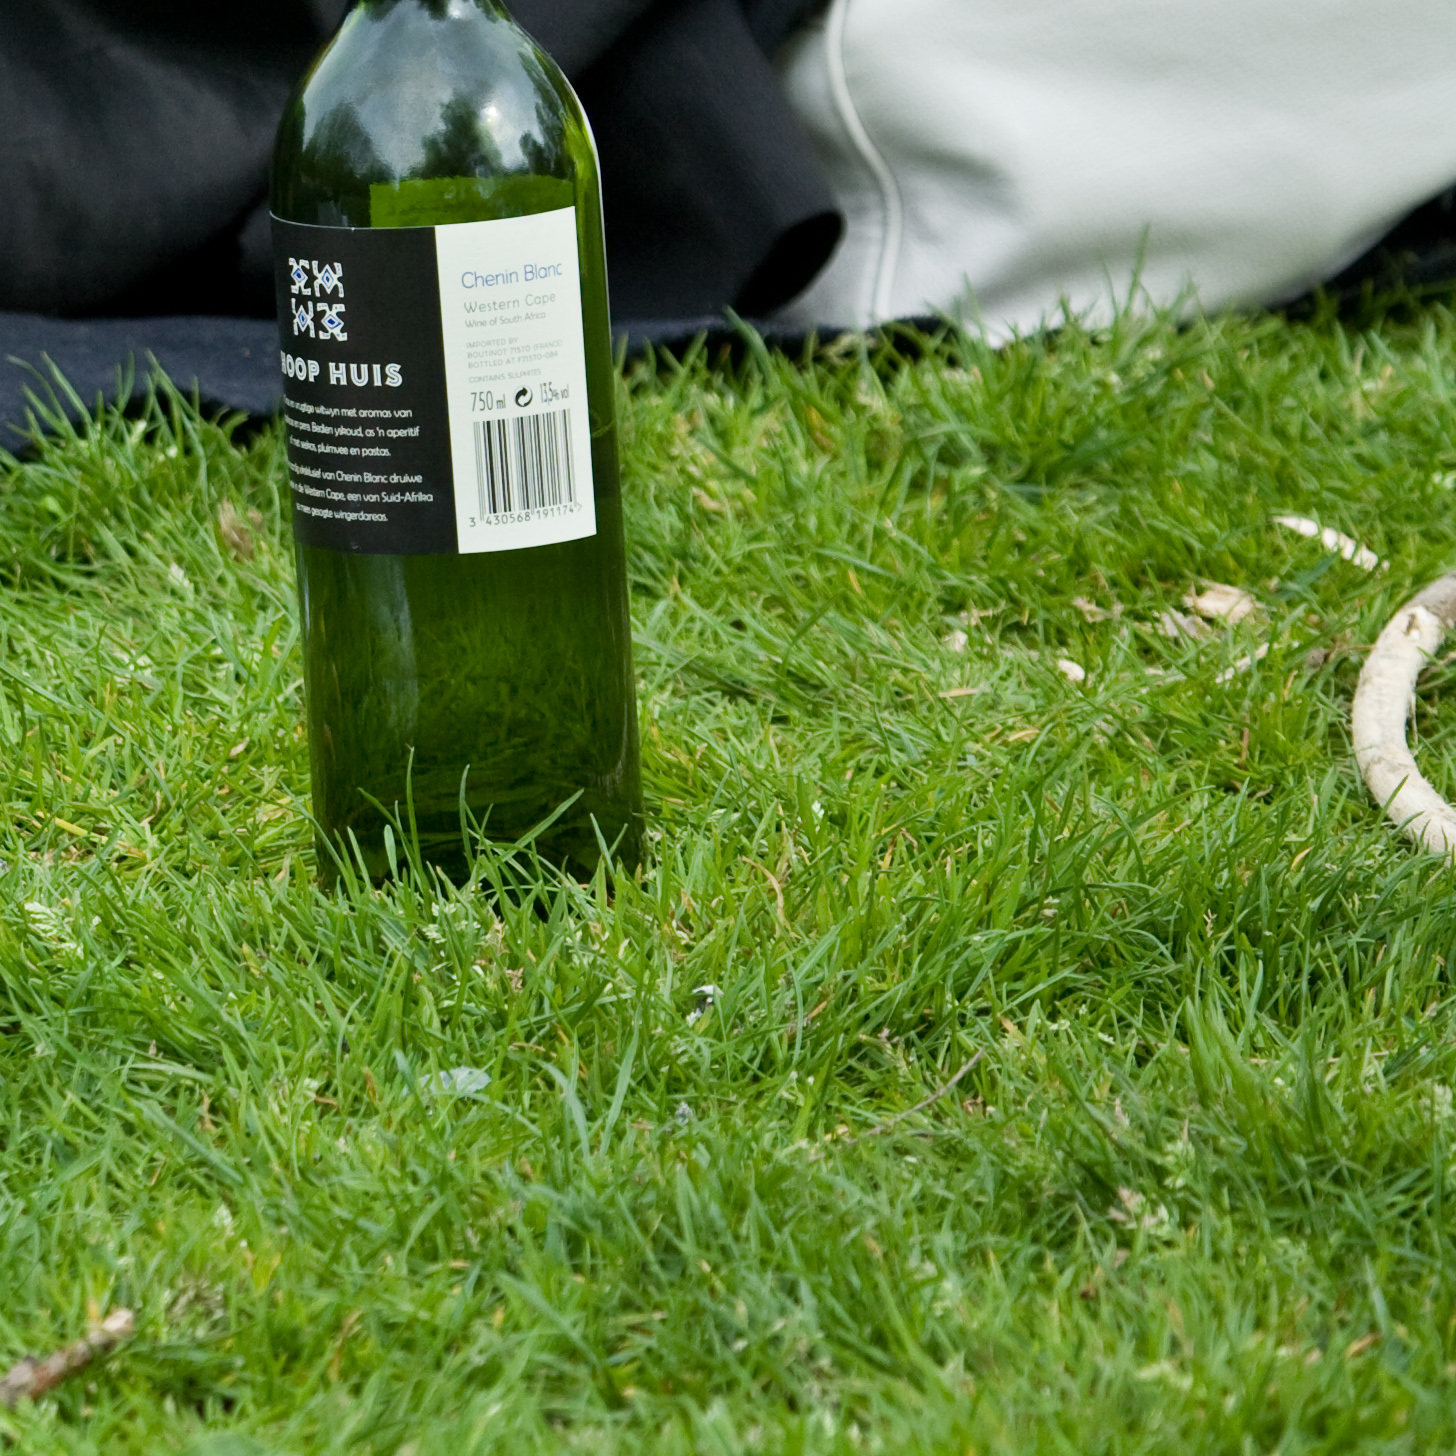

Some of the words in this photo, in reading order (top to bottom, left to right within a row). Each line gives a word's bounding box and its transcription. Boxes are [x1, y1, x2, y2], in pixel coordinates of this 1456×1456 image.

[461, 269, 519, 289] Chenin
[523, 263, 562, 282] Blanc
[463, 299, 520, 314] Western
[525, 293, 556, 307] Cape
[465, 319, 487, 328] Wine
[489, 316, 497, 326] of
[499, 315, 522, 325] South
[524, 312, 546, 322] Africa
[466, 338, 506, 349] IMPORTED
[468, 359, 504, 369] BOTTLED
[505, 357, 515, 365] AT
[328, 362, 403, 387] HUIS
[468, 373, 506, 383] CONTAINS
[470, 391, 494, 412] 750
[496, 394, 507, 409] ml
[341, 408, 358, 417] met
[358, 409, 392, 418] aromas
[393, 409, 413, 418] van
[365, 428, 375, 437] as
[386, 426, 420, 439] aperitif
[350, 447, 361, 455] en
[322, 469, 335, 480] van
[336, 470, 362, 482] Chenin
[363, 472, 388, 483] Blanc
[389, 473, 423, 483] druiwe
[347, 493, 361, 502] een
[363, 493, 380, 502] van
[381, 492, 433, 502] Suid-Afrika
[469, 517, 477, 528] 3
[485, 512, 532, 526] 430568
[536, 505, 574, 519] 191174
